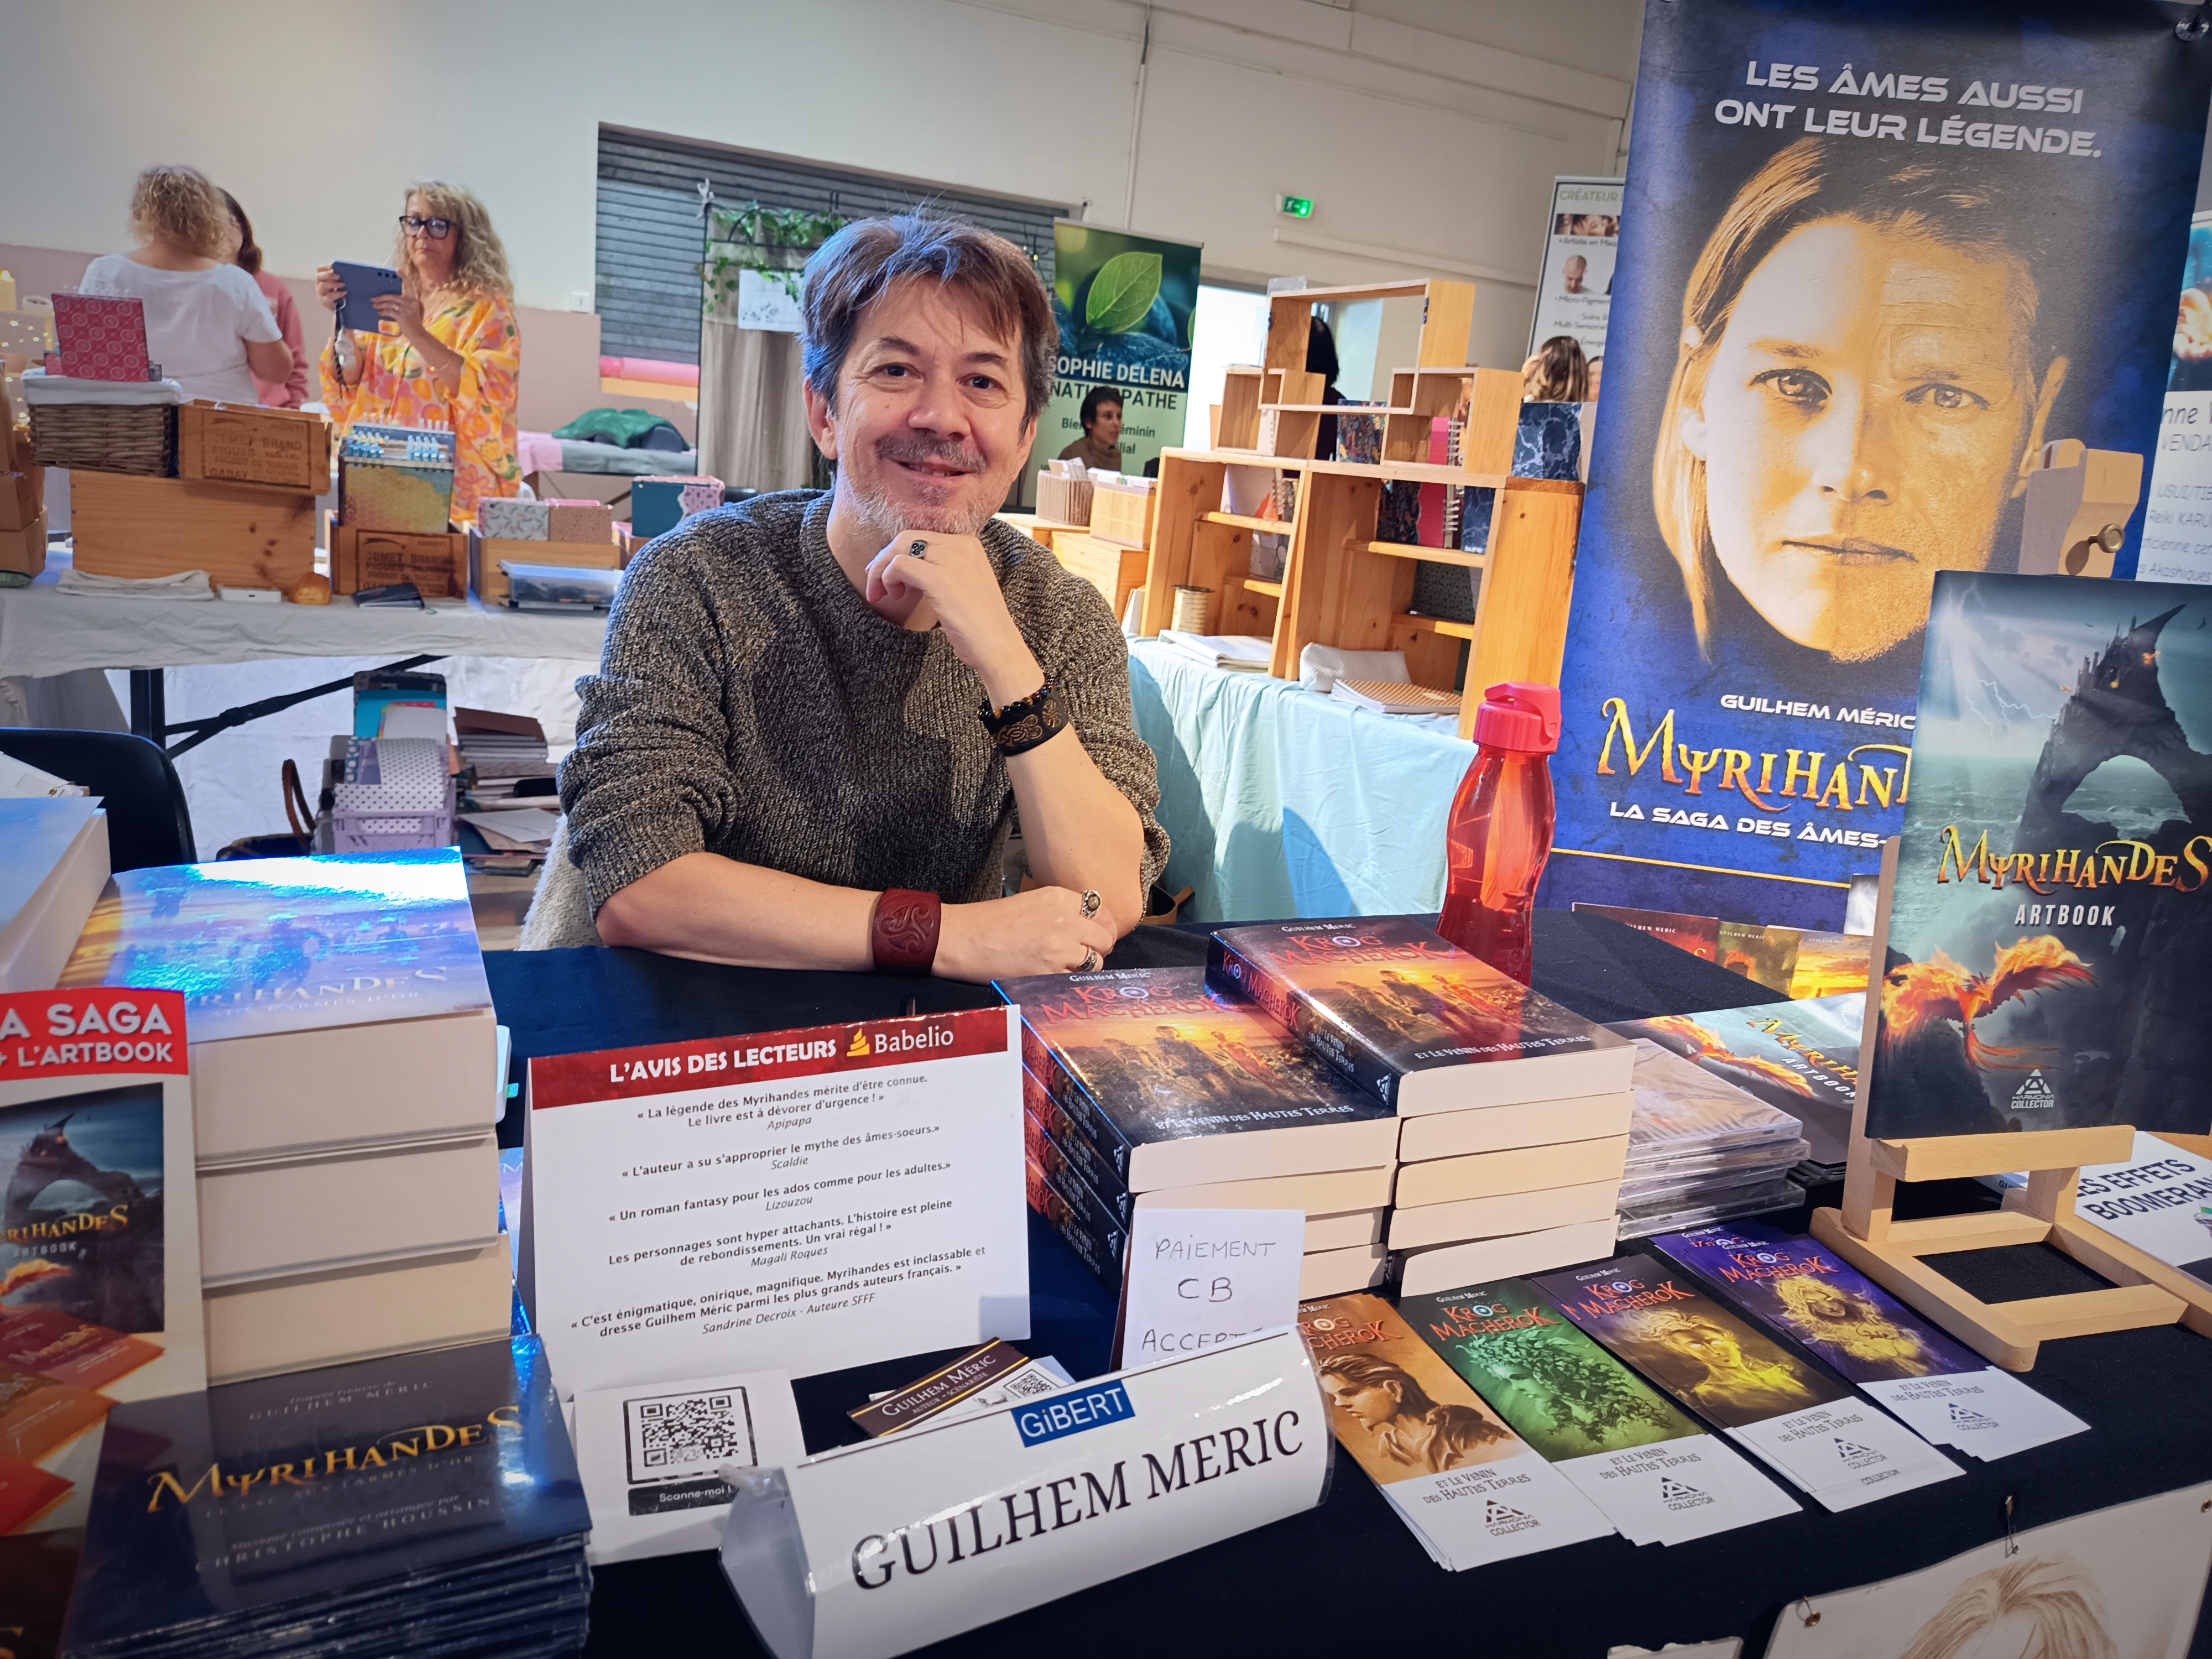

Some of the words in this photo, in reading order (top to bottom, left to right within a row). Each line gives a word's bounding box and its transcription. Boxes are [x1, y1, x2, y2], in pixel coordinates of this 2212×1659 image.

[1746, 61, 1820, 90] LES
[1828, 63, 1949, 102] ÂMES
[1957, 81, 2083, 114] AUSSI
[1714, 99, 1796, 128] ONT
[1804, 109, 1907, 140] LEUR
[1917, 114, 2101, 158] LÉGENDE.
[1048, 356, 1113, 380] SOPHIE
[1117, 364, 1185, 388] DELENA
[1051, 381, 1177, 410] NATPATHE
[1120, 425, 1155, 437] éminin
[2179, 512, 2212, 527] KARU
[1720, 694, 1830, 719] GUILHEM
[1836, 707, 1917, 730] MÉRIC
[1609, 802, 1645, 820] LA
[1652, 807, 1729, 830] SAGA
[1737, 817, 1790, 838] DES
[2015, 904, 2116, 926] ARTBOOK
[1266, 941, 1467, 969] MACHEROK
[1286, 935, 1384, 952] KROG
[1071, 985, 1173, 1004] KROG
[1222, 951, 1246, 984] KROG
[1247, 971, 1301, 1031] MACHEROK
[46, 1001, 173, 1038] SAGA
[1041, 993, 1245, 1024] MACHEROK
[18, 1041, 174, 1068] L'ARTBOOK
[610, 1056, 682, 1083] L'AVIS
[687, 1053, 728, 1074] DES
[733, 1039, 837, 1068] LECTEURS
[874, 1025, 954, 1054] Babelio
[648, 1108, 662, 1119] La
[666, 1101, 714, 1117] légende
[718, 1098, 739, 1109] des
[743, 1089, 810, 1107] Myrihandes
[813, 1084, 849, 1097] mérite
[852, 1080, 884, 1092] d'être
[886, 1076, 927, 1087] connue.
[688, 1118, 701, 1127] Le
[706, 1114, 732, 1125] livre
[735, 1110, 754, 1121] est
[757, 1108, 764, 1118] à
[767, 1103, 812, 1117] dévorer
[815, 1096, 869, 1110] d'urgence
[2011, 1100, 2054, 1109] COLLECTOR
[766, 1117, 812, 1131] Apipapa
[1190, 1115, 1229, 1125] VENIN
[1248, 1109, 1302, 1121] HAUTES
[1300, 1105, 1354, 1117] TERRES
[633, 1162, 683, 1177] L'auteur
[687, 1161, 693, 1169] a
[698, 1158, 712, 1167] su
[716, 1146, 787, 1165] s'approprier
[791, 1144, 801, 1154] le
[805, 1138, 839, 1152] mythe
[842, 1135, 862, 1146] des
[865, 1126, 940, 1142] âmes-soeurs.»
[770, 1156, 808, 1170] Scaldie
[620, 1210, 637, 1220] Un
[641, 1204, 680, 1218] roman
[684, 1196, 729, 1211] fantasy
[732, 1191, 760, 1205] pour
[763, 1188, 780, 1198] les
[783, 1183, 810, 1194] ados
[813, 1177, 853, 1190] comme
[857, 1172, 883, 1185] pour
[886, 1168, 901, 1178] les
[904, 1162, 951, 1176] adultes.»
[2077, 1177, 2111, 1197] ES
[2098, 1159, 2195, 1189] EFFETS
[765, 1197, 813, 1211] Lizouzou
[2083, 1173, 2212, 1220] BOOMERAN
[0, 1204, 129, 1246] RIHANDES
[609, 1254, 629, 1265] Les
[634, 1240, 712, 1263] personnages
[716, 1234, 742, 1246] sont
[746, 1228, 779, 1242] hyper
[782, 1218, 844, 1235] attachants.
[847, 1208, 898, 1224] L'histoire
[901, 1205, 917, 1215] est
[920, 1200, 952, 1214] pleine
[13, 1241, 78, 1259] ARTBOOK
[680, 1255, 695, 1266] de
[699, 1239, 802, 1263] rebondissements.
[806, 1234, 821, 1244] Un
[824, 1228, 845, 1241] vrai
[849, 1223, 877, 1237] régal
[750, 1252, 787, 1267] Magali
[790, 1247, 828, 1260] Roques
[1718, 1255, 1840, 1283] MACHEROK
[1727, 1252, 1791, 1268] KROG
[581, 1313, 612, 1327] C'est
[616, 1298, 696, 1320] énigmatique,
[700, 1288, 753, 1303] onirique,
[756, 1275, 823, 1293] magnifique.
[827, 1262, 890, 1281] Myrihandes
[894, 1258, 910, 1269] est
[913, 1248, 972, 1265] inclassable
[975, 1246, 985, 1255] et
[599, 1322, 641, 1337] dresse
[645, 1311, 696, 1328] Guilhem
[700, 1303, 732, 1317] Méric
[736, 1295, 770, 1313] parmi
[774, 1293, 790, 1304] les
[794, 1288, 818, 1302] plus
[821, 1280, 860, 1297] grands
[863, 1273, 904, 1287] auteurs
[907, 1264, 953, 1279] français.
[1178, 1276, 1233, 1303] CB
[1578, 1280, 1695, 1319] MACHEROK
[1583, 1279, 1645, 1301] KROG
[702, 1318, 752, 1334] Sandrine
[755, 1308, 796, 1324] Decroix
[806, 1300, 848, 1314] Auteure
[851, 1292, 875, 1306] SFFF
[1429, 1306, 1560, 1342] MACHEROK
[1440, 1303, 1509, 1324] KROG
[881, 1380, 948, 1417] GUILHEM
[946, 1354, 996, 1385] MÉRIC
[912, 1397, 941, 1415] AUTEUR
[1957, 1422, 2002, 1431] COLLECTOR
[145, 1405, 524, 1514] MYRIHANDES
[1599, 1471, 1619, 1479] DES
[1615, 1461, 1661, 1477] HAUTES
[1656, 1453, 1702, 1468] TERRES
[1422, 1494, 1442, 1504] DES
[1439, 1484, 1487, 1500] HAUTES
[1483, 1474, 1531, 1490] TERRES
[1435, 1480, 1449, 1489] ET
[1447, 1477, 1464, 1485] LE
[1460, 1468, 1497, 1483] VENIN
[1861, 1469, 1902, 1485] COLLECTOR
[659, 1485, 725, 1503] Scanne-moi
[851, 1460, 1132, 1590] GUILHEM
[1141, 1410, 1304, 1500] MERIC
[1668, 1496, 1717, 1511] COLLECTOR
[1490, 1519, 1541, 1536] COLLECTOR
